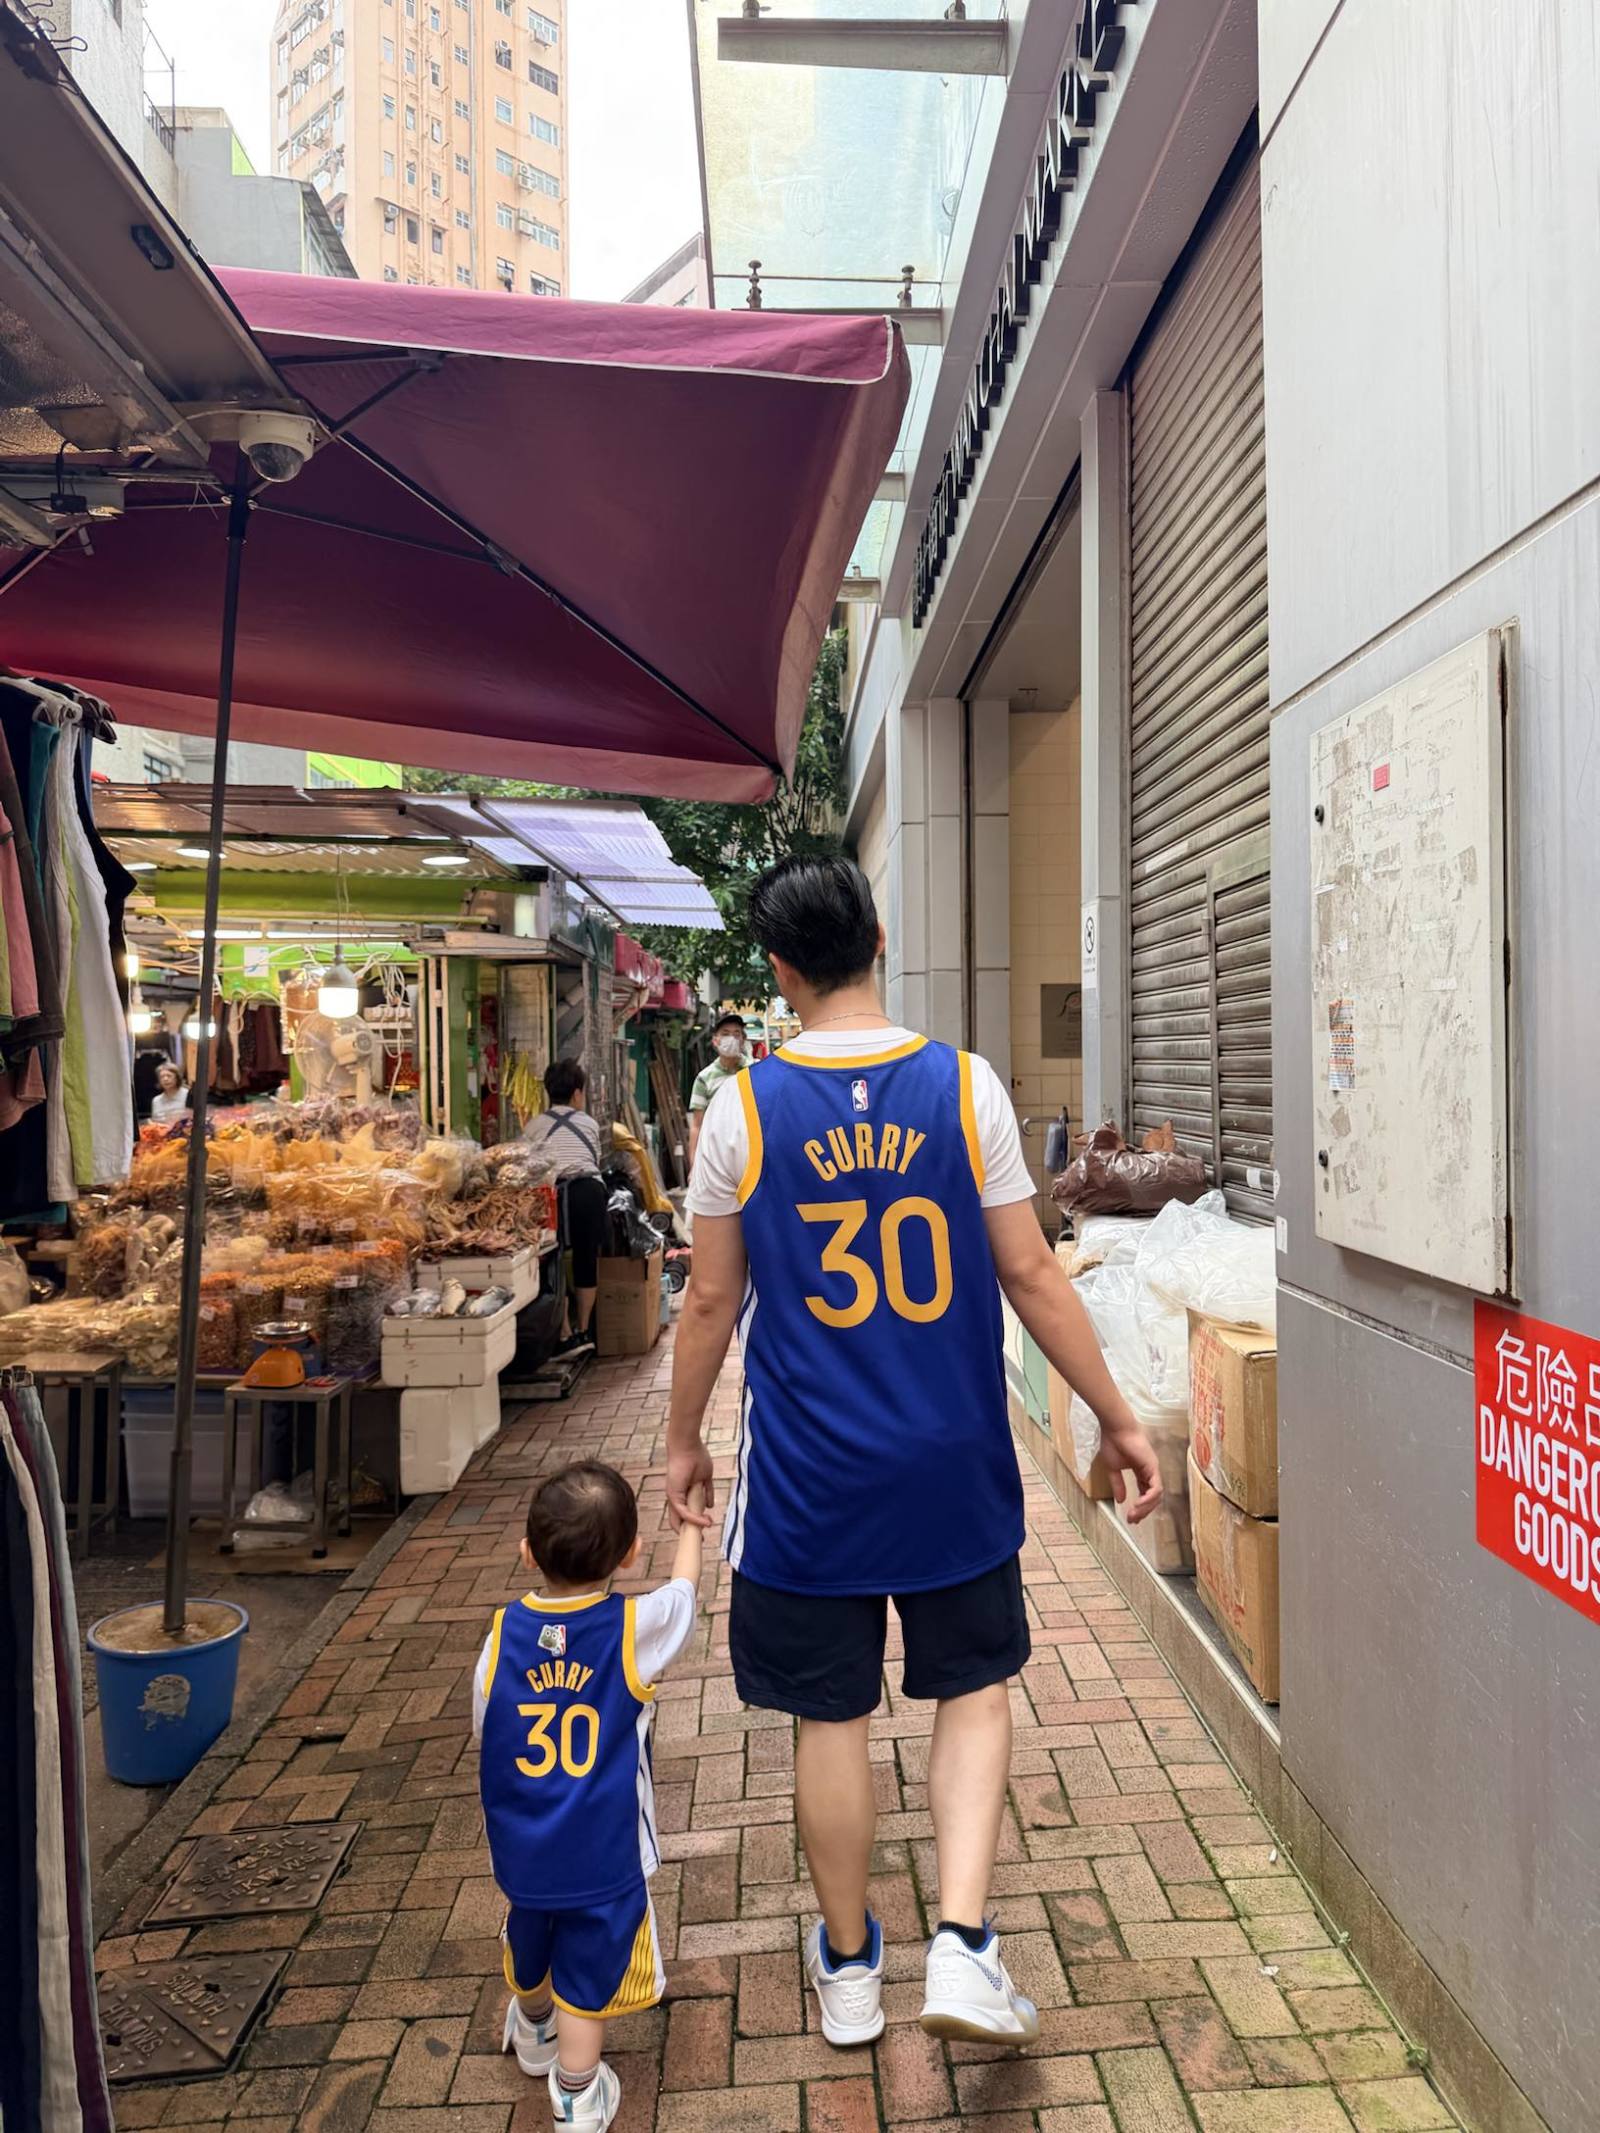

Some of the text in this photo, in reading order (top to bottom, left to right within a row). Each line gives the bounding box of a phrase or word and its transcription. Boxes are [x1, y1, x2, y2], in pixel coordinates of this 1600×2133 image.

[1023, 0, 1119, 284] MARKE
[803, 1123, 926, 1182] CURRY
[795, 1196, 953, 1329] 30
[526, 1660, 594, 1694] CURRY
[515, 1703, 600, 1778] 30
